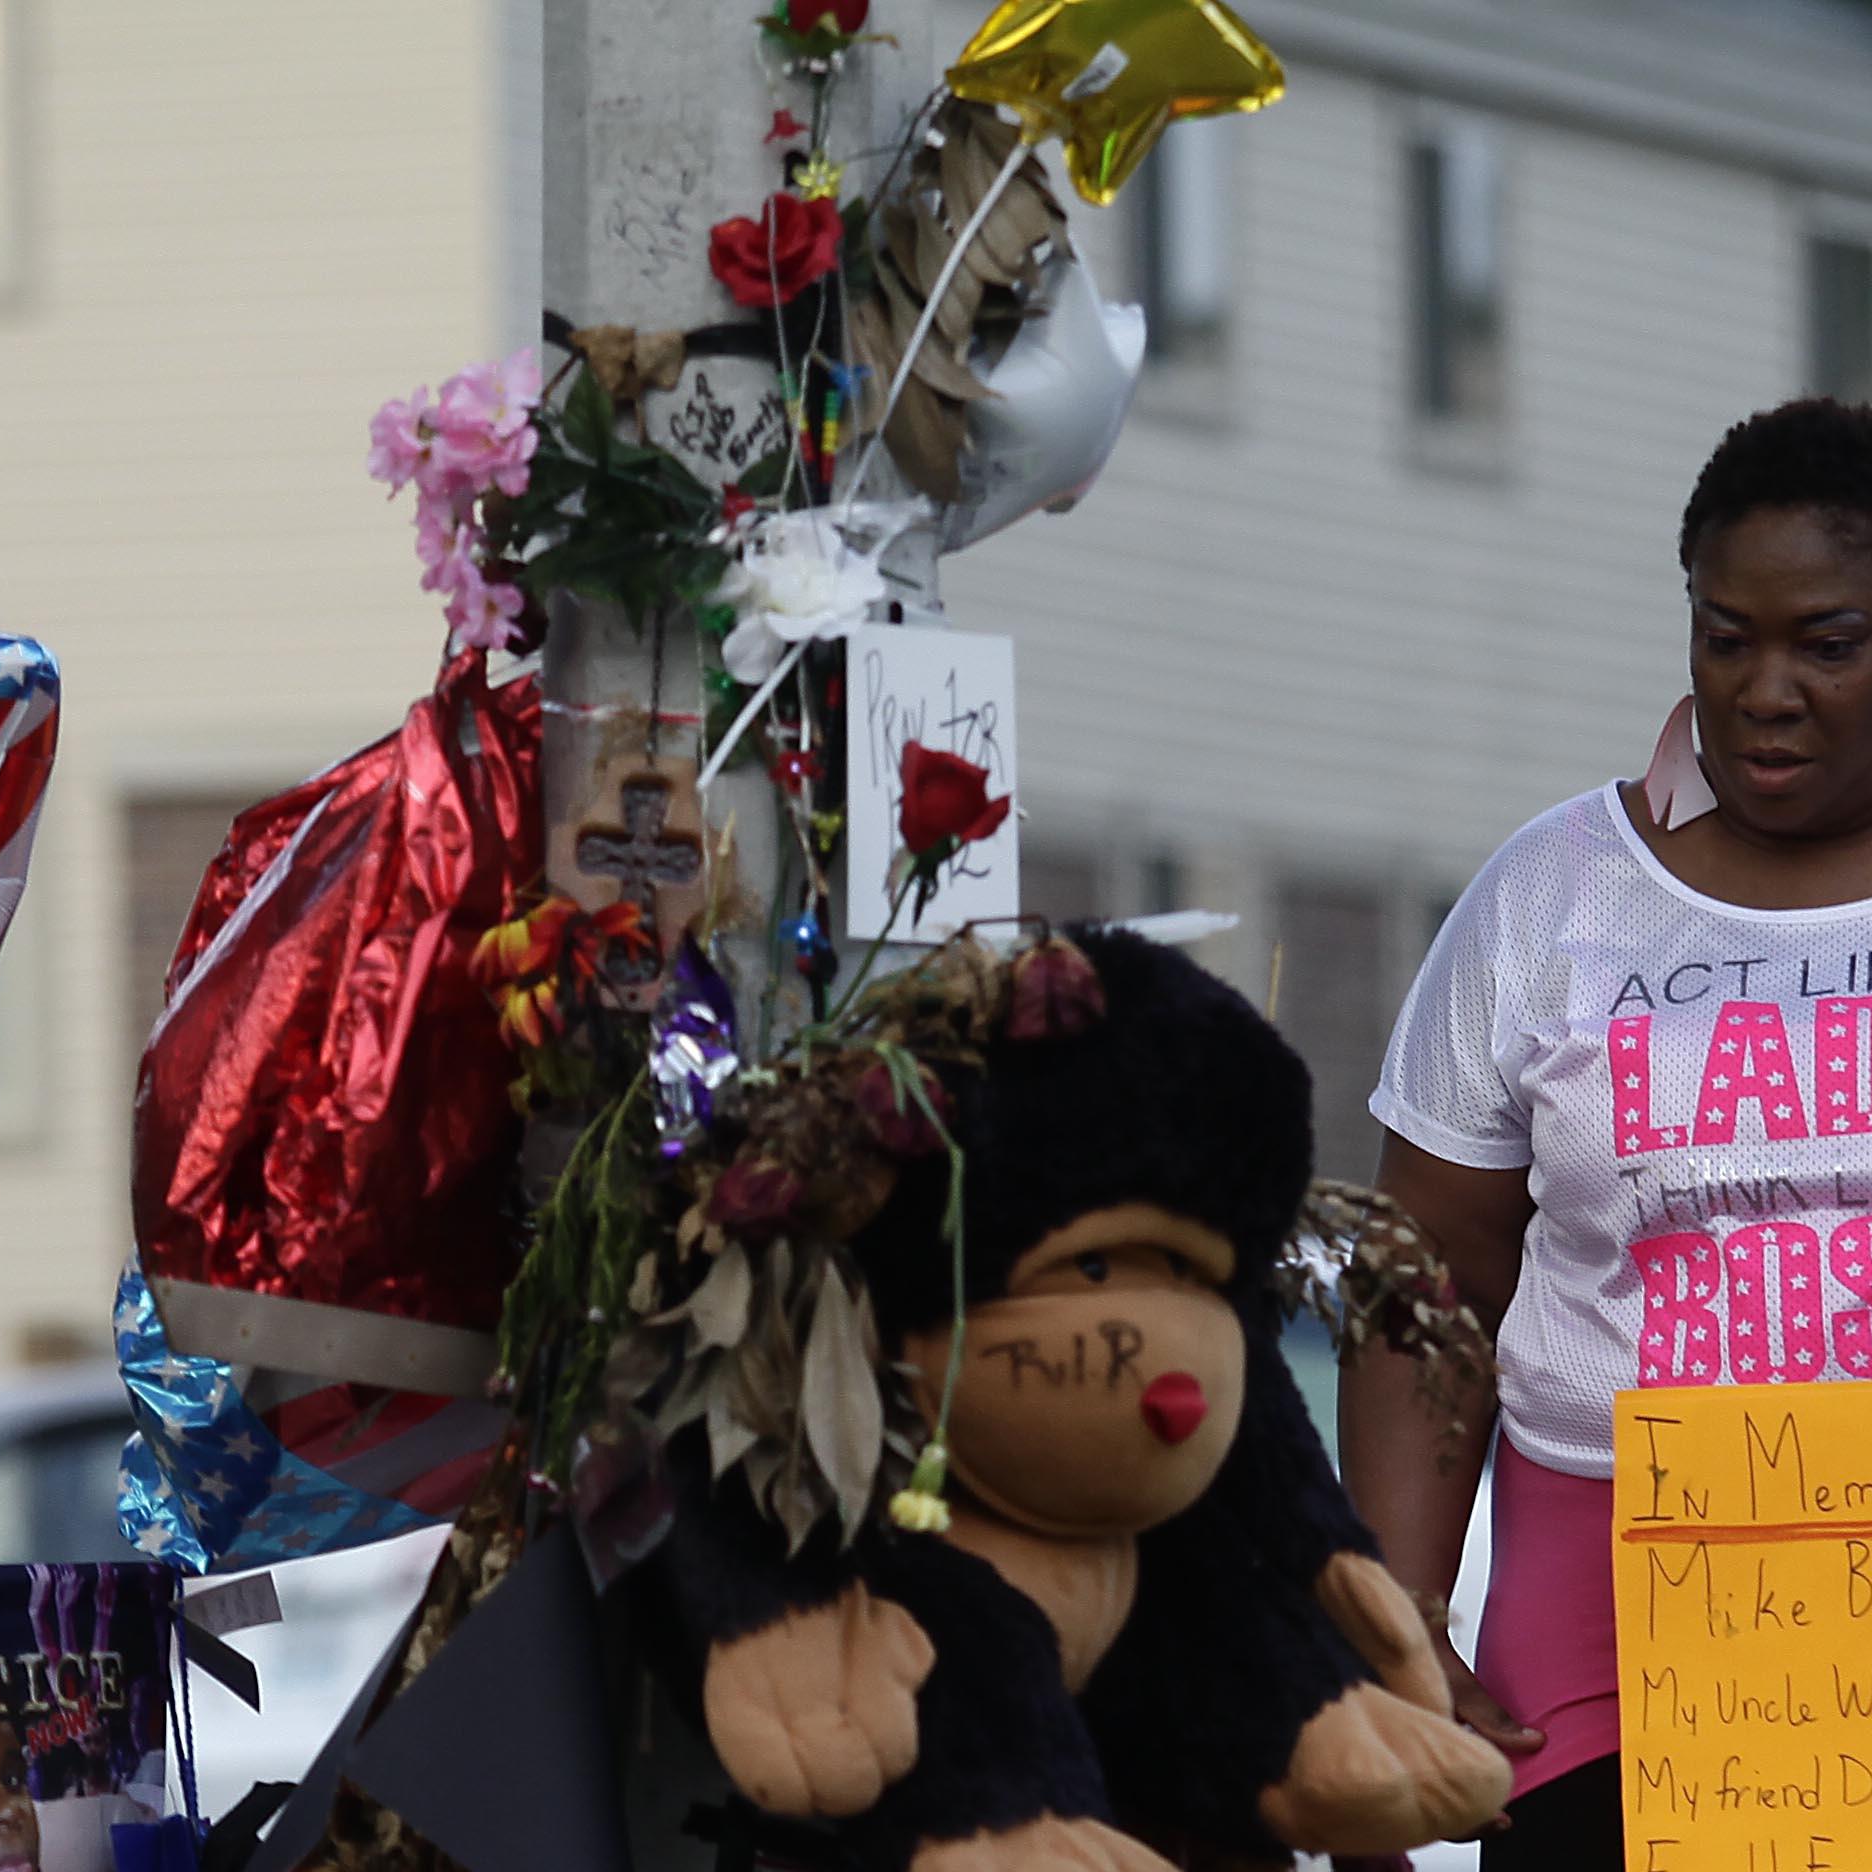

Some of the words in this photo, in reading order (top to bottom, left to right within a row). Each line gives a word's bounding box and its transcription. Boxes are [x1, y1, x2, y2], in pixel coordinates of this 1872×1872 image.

[1608, 960, 1781, 1016] ACT
[1618, 1158, 1812, 1231] THINK
[1646, 1540, 1813, 1642] Mike
[1640, 1666, 1697, 1737] My
[1714, 1672, 1820, 1729] Uncle
[1636, 1753, 1698, 1823] My
[1714, 1754, 1823, 1812] friend
